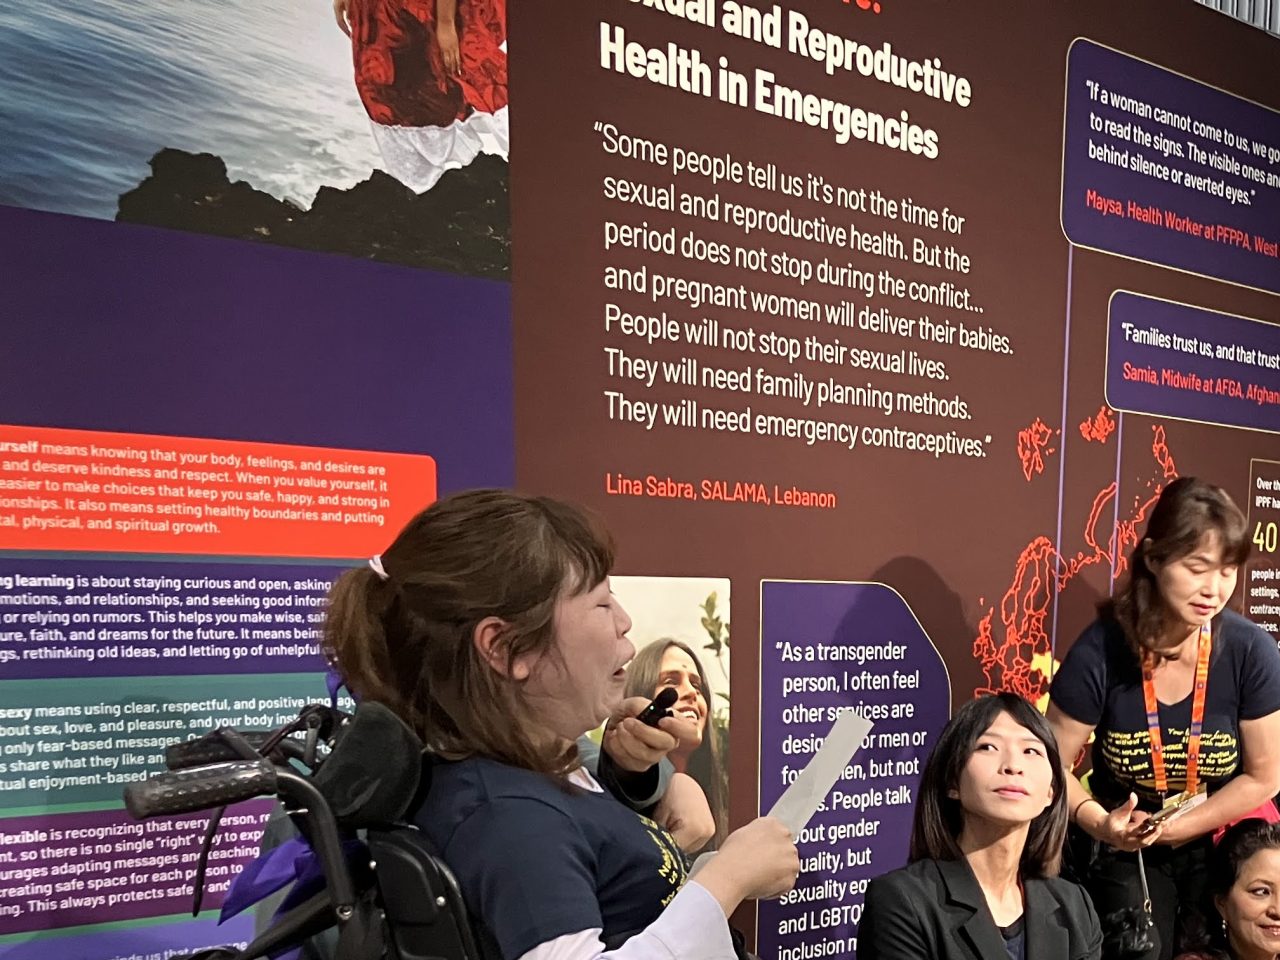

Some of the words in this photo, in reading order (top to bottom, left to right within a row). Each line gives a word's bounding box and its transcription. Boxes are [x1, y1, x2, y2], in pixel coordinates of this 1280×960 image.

[722, 1, 781, 48] and
[789, 10, 970, 106] Reproductive
[601, 22, 711, 96] Health
[719, 57, 747, 106] in
[755, 69, 938, 158] Emergencies
[1101, 90, 1108, 104] a
[1110, 92, 1151, 118] woman
[1154, 108, 1191, 132] cannot
[1193, 122, 1222, 142] come
[1224, 129, 1234, 146] to
[1236, 136, 1250, 154] us,
[1252, 142, 1266, 157] we
[1268, 148, 1280, 164] go
[674, 148, 742, 184] people
[747, 162, 776, 191] tell
[781, 174, 802, 196] us
[808, 174, 833, 204] it's
[838, 188, 866, 212] not
[870, 191, 897, 219] the
[901, 198, 938, 228] time
[942, 208, 965, 234] for
[1128, 202, 1162, 225] Health
[1165, 212, 1203, 235] Worker
[1204, 226, 1214, 240] at
[1255, 237, 1277, 256] West
[606, 304, 679, 344] People
[684, 319, 718, 346] will
[724, 328, 755, 352] not
[759, 332, 800, 363] stop
[805, 336, 847, 364] their
[850, 348, 905, 373] sexual
[909, 352, 949, 380] lives.
[1173, 334, 1198, 354] trust
[1200, 342, 1214, 358] us,
[1216, 344, 1234, 360] and
[1237, 346, 1256, 364] that
[1258, 351, 1280, 369] trust
[1162, 369, 1201, 391] Midwife
[1203, 379, 1213, 392] at
[604, 391, 658, 429] They
[663, 400, 696, 427] will
[702, 407, 750, 432] need
[756, 415, 858, 449] emergency
[607, 474, 642, 495] Lina
[646, 476, 696, 500] Sabra,
[702, 480, 770, 504] SALAMA,
[775, 486, 835, 507] Lebanon
[1257, 478, 1272, 490] Over
[1256, 496, 1271, 507] IPPF
[87, 518, 112, 529] and
[116, 520, 169, 532] spiritual
[1253, 522, 1277, 552] 40
[16, 574, 74, 590] learning
[77, 575, 89, 586] is
[92, 576, 130, 587] about
[134, 576, 181, 591] staying
[184, 577, 231, 588] curious
[234, 578, 256, 589] and
[259, 581, 291, 592] open,
[294, 579, 331, 592] asking
[805, 646, 814, 661] a
[817, 642, 907, 665] transgender
[784, 677, 840, 697] person,
[844, 672, 848, 690] I
[852, 671, 889, 690] often
[893, 670, 918, 688] feel
[0, 708, 32, 720] sexy
[35, 706, 81, 717] means
[84, 703, 120, 717] using
[234, 698, 255, 710] and
[259, 697, 304, 711] positive
[50, 829, 62, 840] is
[66, 823, 143, 839] recognizing
[146, 821, 172, 832] that
[176, 819, 209, 830] every
